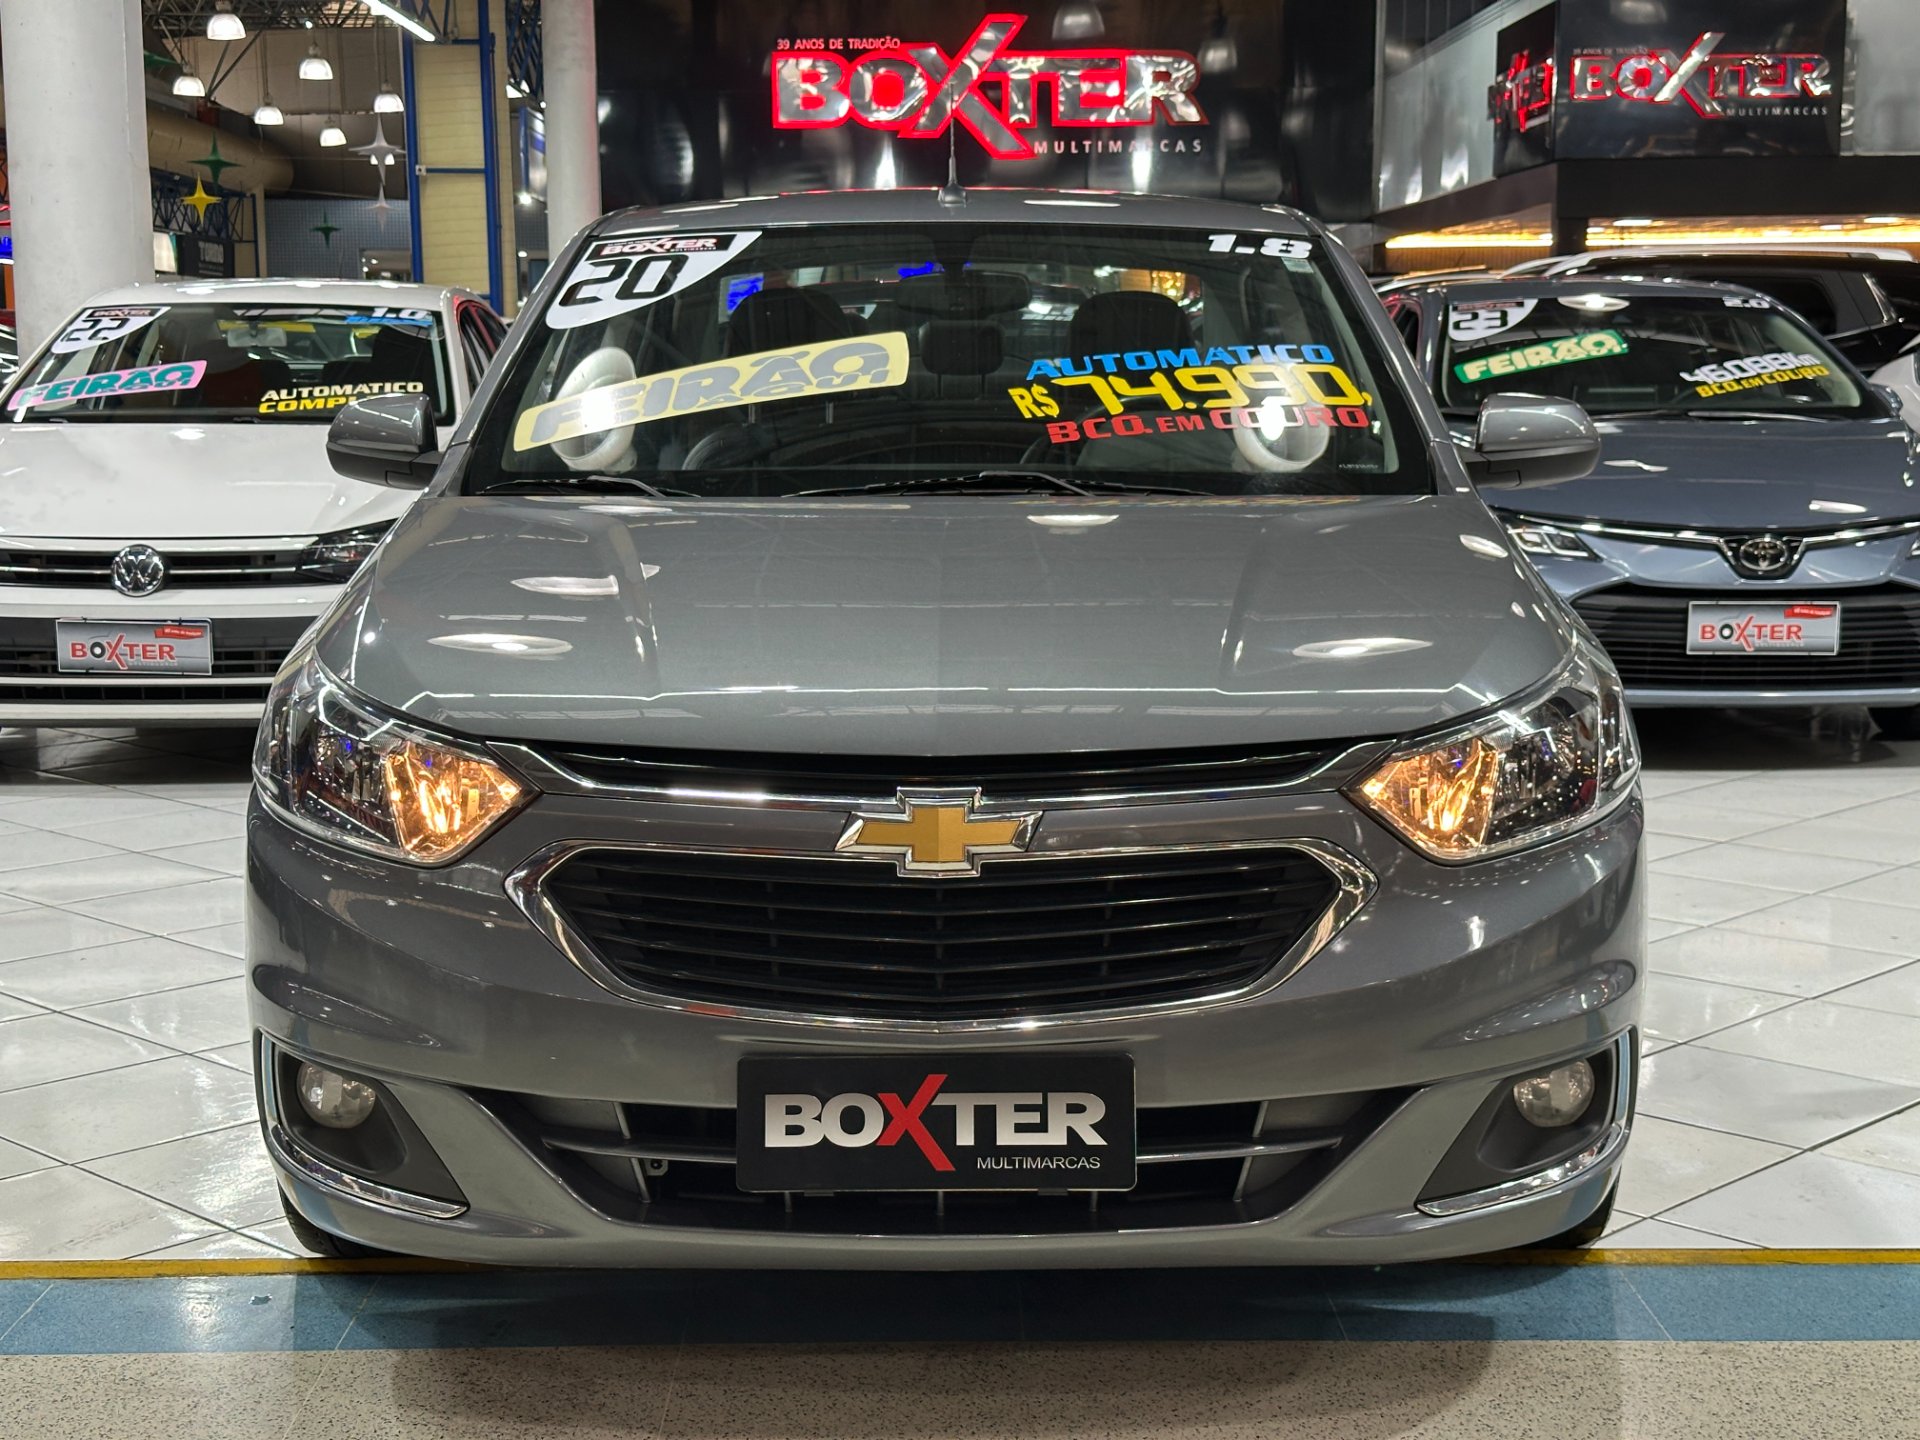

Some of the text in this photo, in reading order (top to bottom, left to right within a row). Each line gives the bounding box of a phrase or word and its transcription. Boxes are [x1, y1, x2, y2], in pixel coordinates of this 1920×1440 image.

[776, 35, 901, 51] 39 ANOS DE TRADIÇÃO
[772, 14, 1209, 160] BOXTER
[1569, 31, 1834, 119] BOXTER
[1726, 105, 1829, 117] MULTIMARCAS
[1033, 139, 1202, 155] MULTIMARCAS
[599, 237, 718, 256] BOXTER
[558, 253, 690, 308] 20
[372, 307, 428, 319] 1.0
[1452, 310, 1508, 330] 23
[61, 317, 131, 342] 22
[1026, 344, 1335, 381] AUTOMATICO
[1463, 333, 1622, 380] FEIRÃO
[18, 364, 196, 406] FEIRÃO
[261, 382, 424, 402] AUTOMATICO
[530, 342, 891, 444] FEIRÃO
[1743, 377, 1764, 390] EM
[1761, 364, 1830, 386] COURO
[1008, 383, 1060, 419] R$
[1156, 414, 1205, 433] EM
[1210, 405, 1370, 431] COURO
[1698, 614, 1804, 652] BOXTER
[70, 632, 177, 670] BOXTER
[764, 1073, 1109, 1171] BOXTER
[976, 1156, 1101, 1170] MULTIMARCAS
